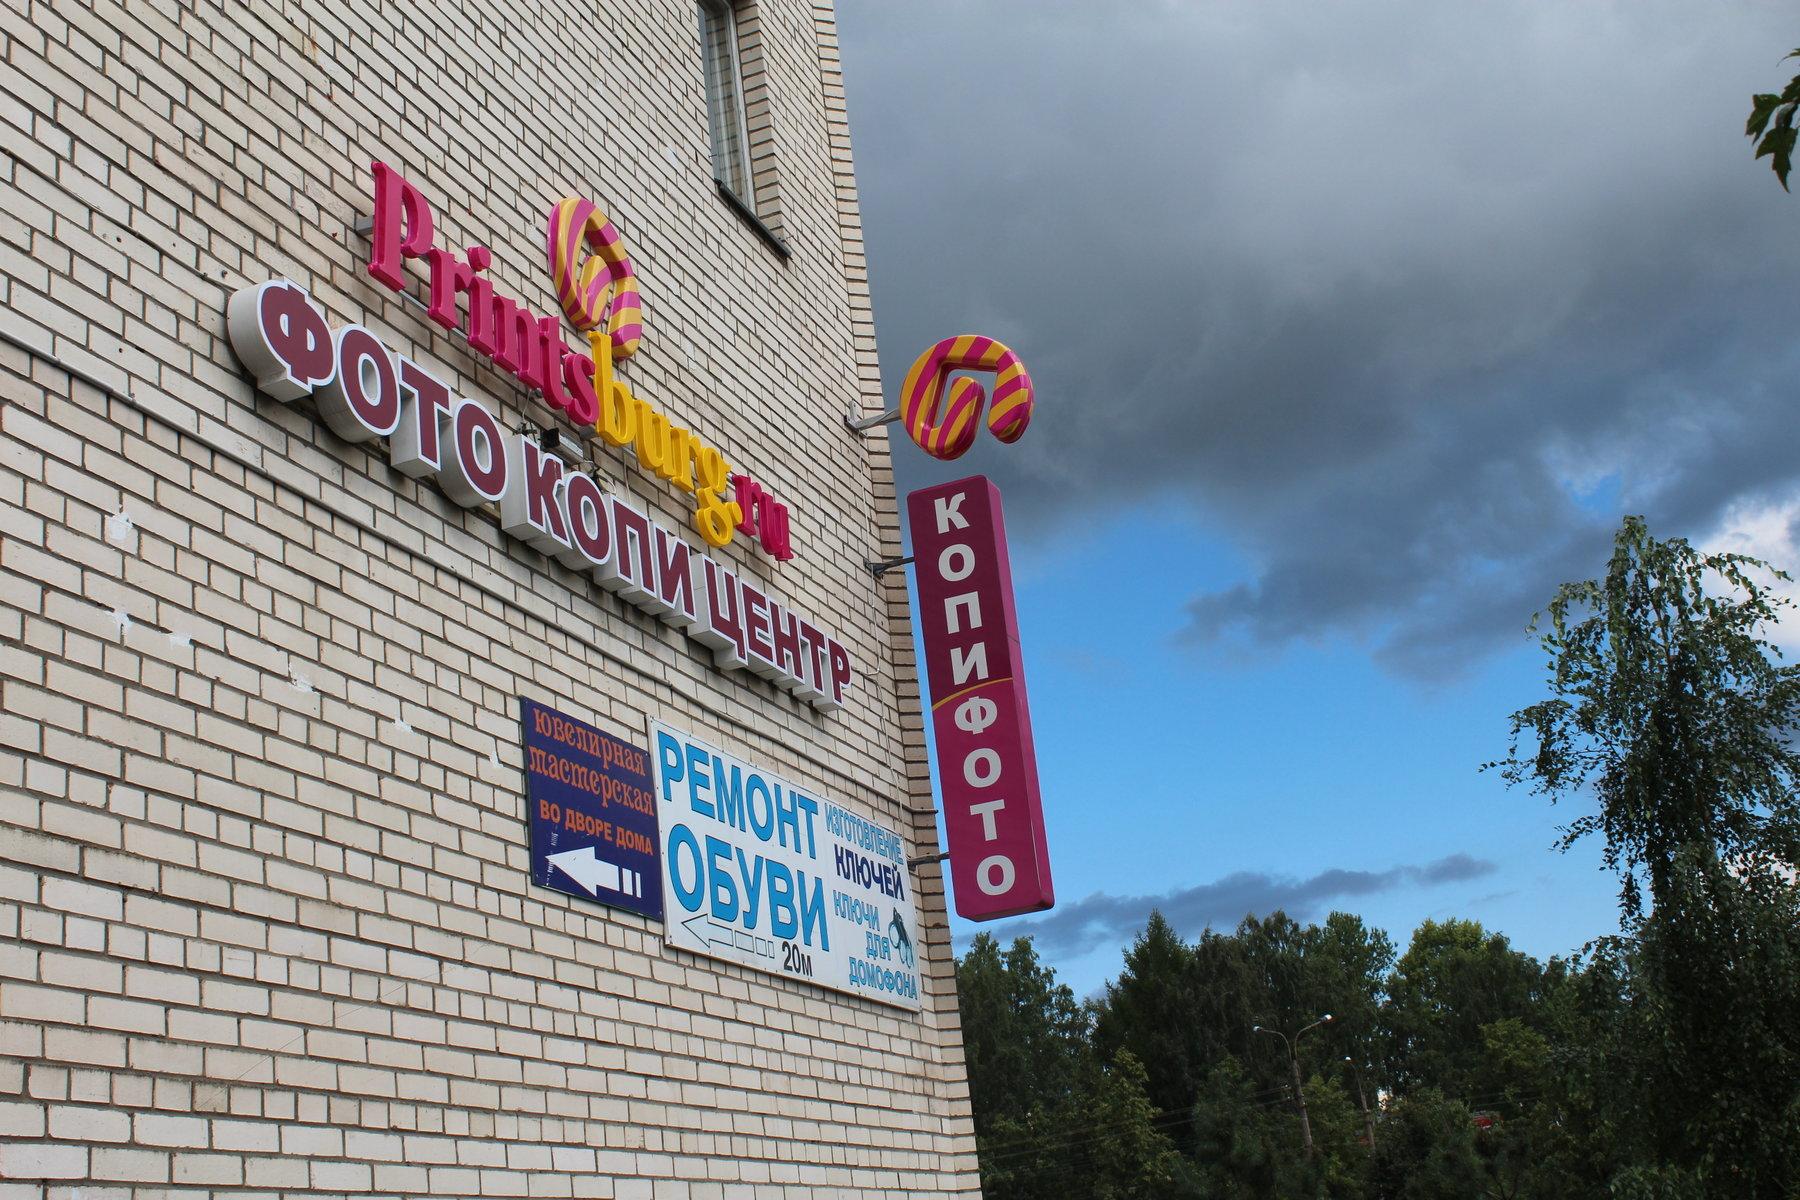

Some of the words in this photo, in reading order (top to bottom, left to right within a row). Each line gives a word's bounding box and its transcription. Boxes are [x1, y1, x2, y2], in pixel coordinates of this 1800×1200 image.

[657, 730, 819, 860] РЕМОНТ
[539, 799, 561, 824] ВО
[564, 808, 613, 843] ДВОРЕ
[616, 825, 654, 857] ДОМА
[824, 802, 904, 866] ИЗГОТОВЛЕНИЕ
[667, 823, 830, 952] ОБУВИ
[834, 843, 905, 902] КЛЮЧЕЙ
[833, 889, 880, 932] КЛЮЧИ
[865, 930, 892, 961] ДЛЯ
[848, 955, 918, 1001] ДОМОФОНА
